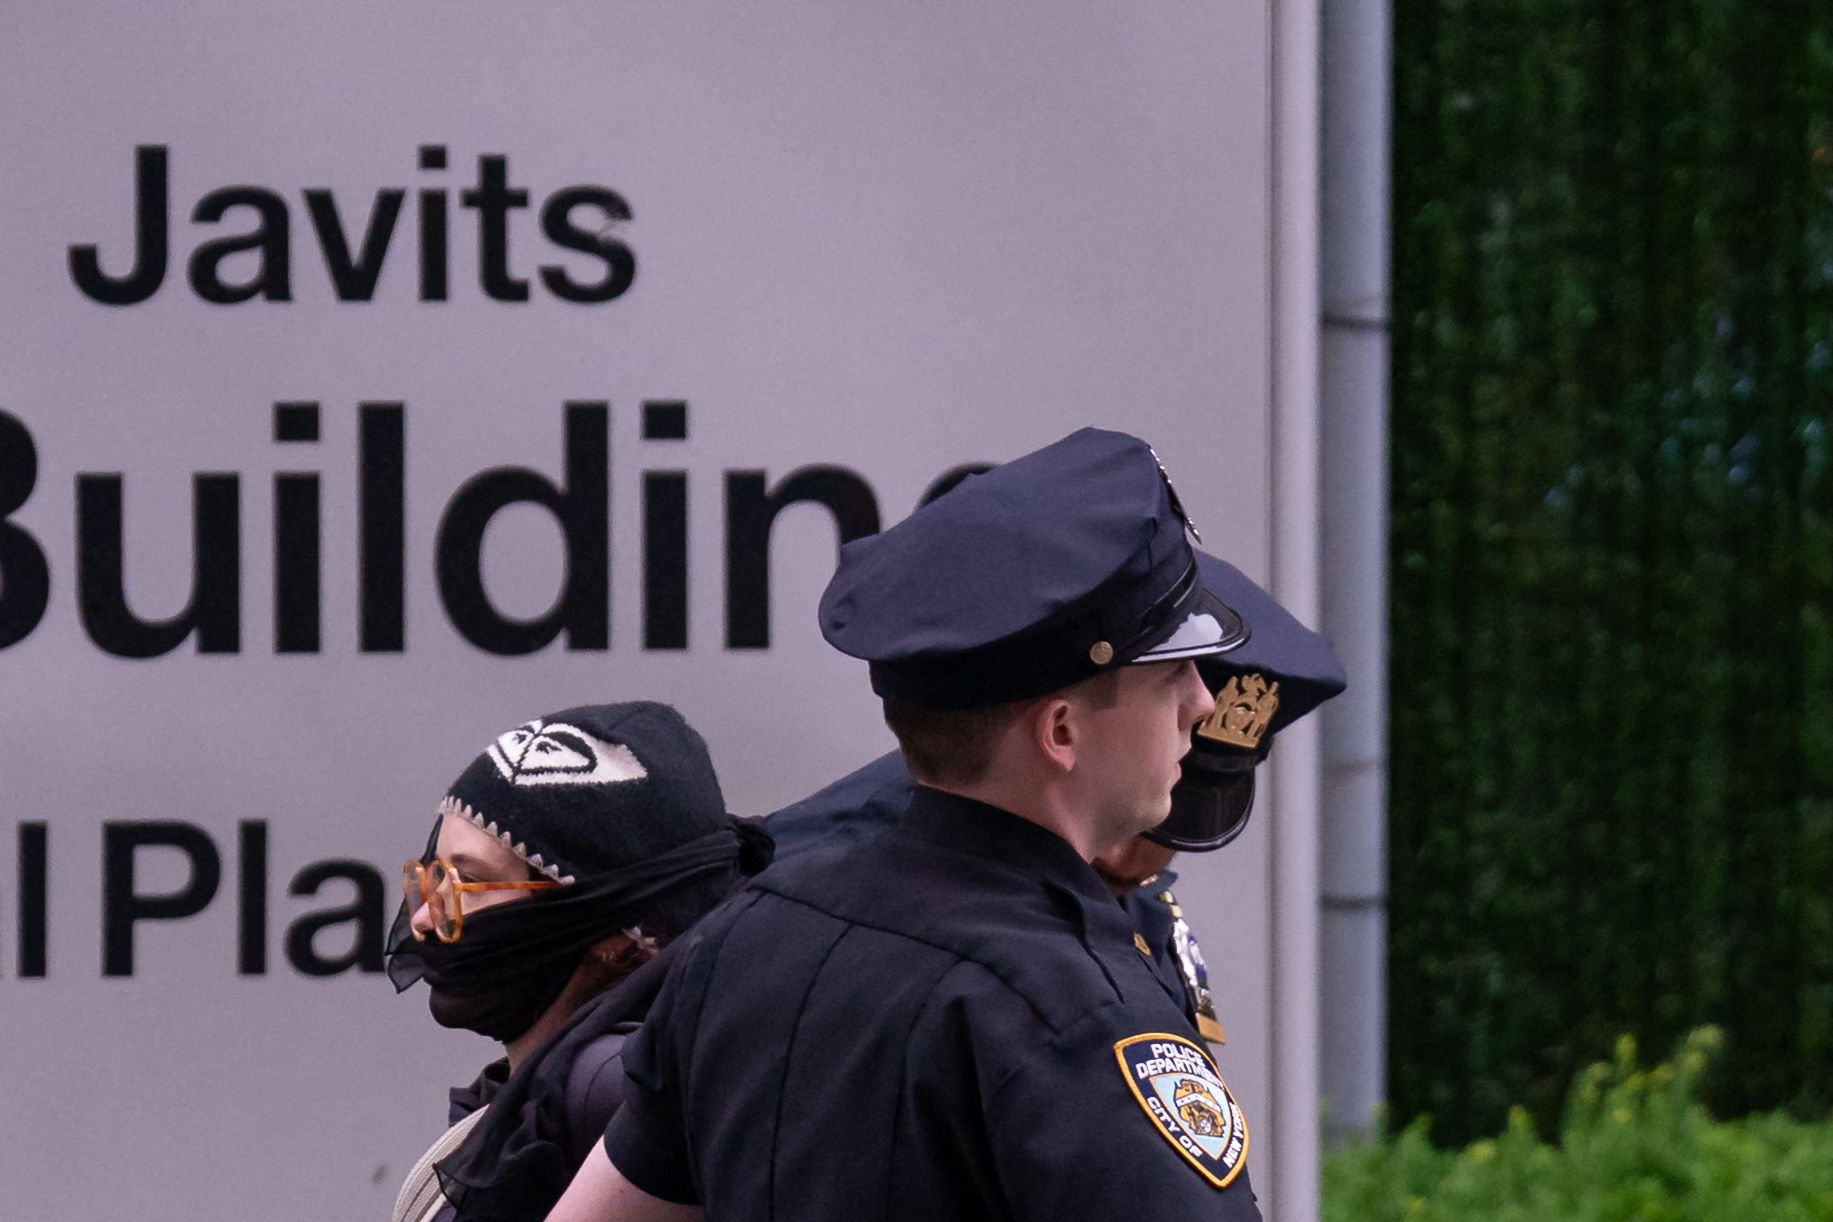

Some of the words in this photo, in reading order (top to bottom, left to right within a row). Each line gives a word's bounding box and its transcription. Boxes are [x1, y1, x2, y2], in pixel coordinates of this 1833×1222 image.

[67, 143, 637, 307] Javits
[100, 818, 386, 979] Pla
[1150, 1043, 1206, 1068] POLICE
[1147, 1096, 1181, 1132] CITY
[1179, 1135, 1203, 1157] OF
[1222, 1136, 1242, 1168] NEW
